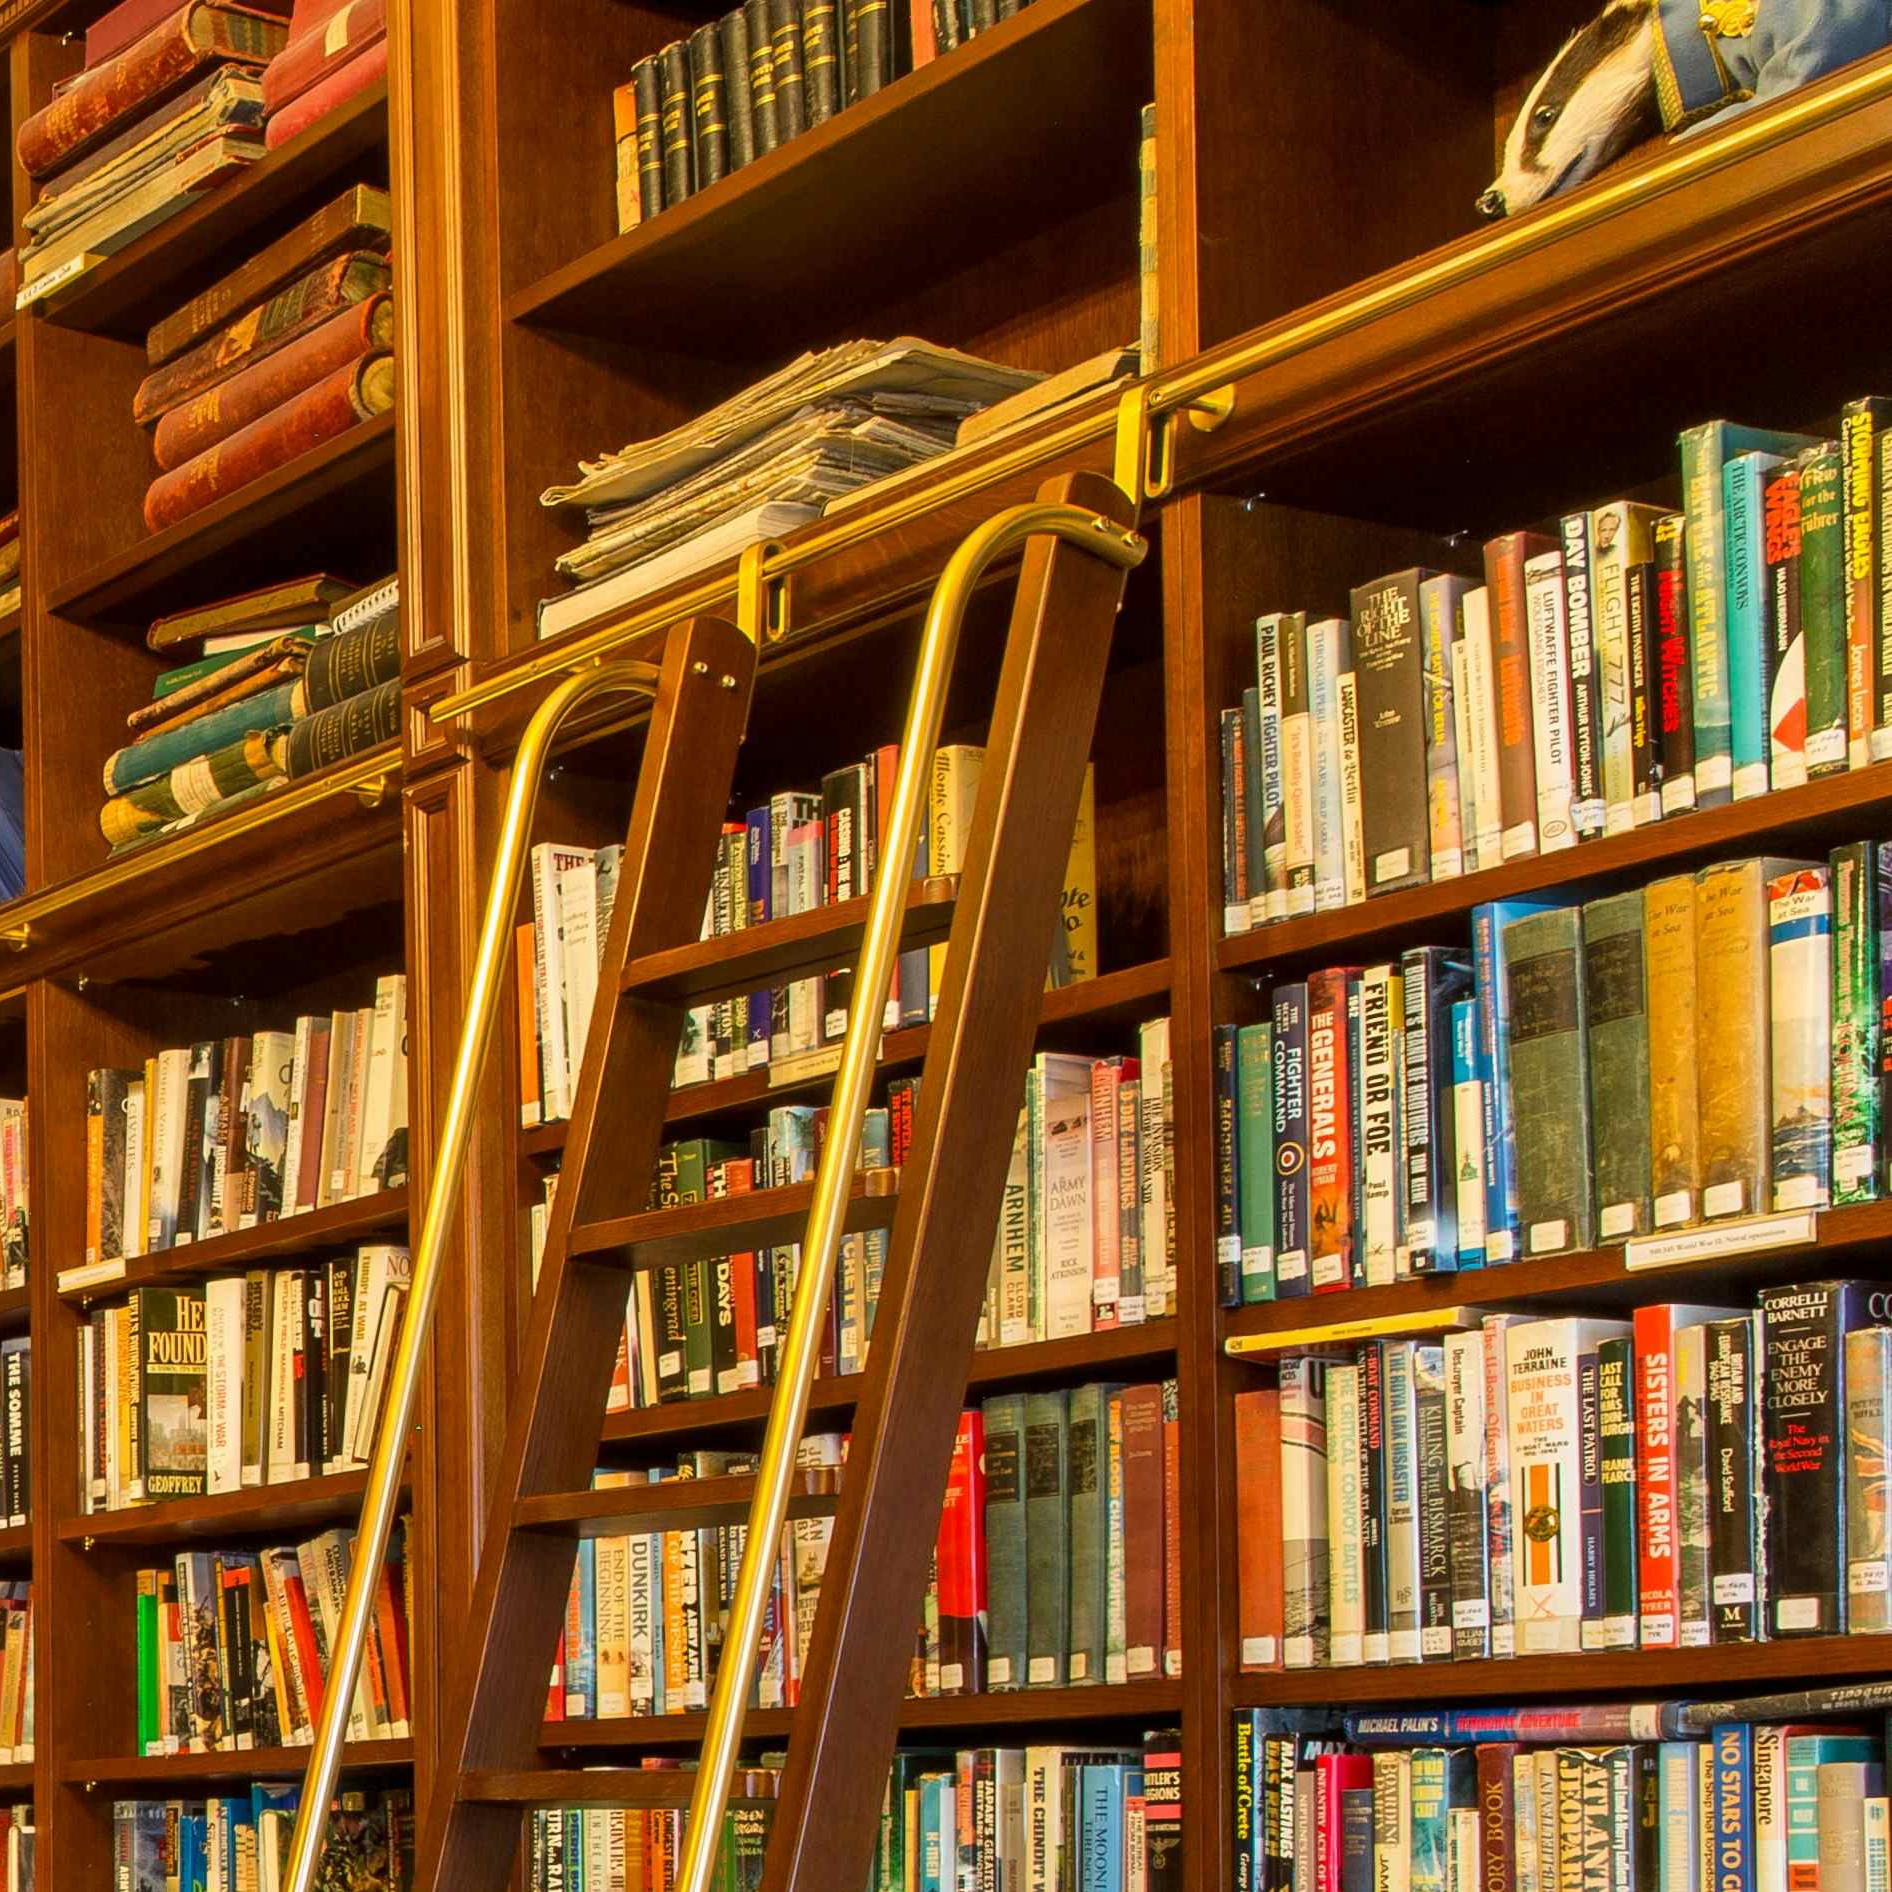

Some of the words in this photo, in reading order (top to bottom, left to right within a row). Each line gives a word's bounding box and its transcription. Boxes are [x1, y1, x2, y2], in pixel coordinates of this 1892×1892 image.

[1850, 412, 1872, 510] STORMING
[1563, 520, 1586, 567] DAY
[1851, 511, 1871, 578] EAGLES
[1604, 563, 1622, 642] FLIGHT
[1262, 625, 1275, 659] PAUL
[1543, 591, 1557, 666] LUFTWAFFE
[1568, 573, 1591, 679] BOMBER
[1263, 662, 1277, 710] RICHEY
[1609, 647, 1625, 703] 777
[1547, 669, 1560, 725] FIGHTER
[1264, 714, 1279, 769] FIGHTER
[1550, 728, 1562, 764] PILOT
[1266, 772, 1280, 809] PILOT
[1775, 900, 1789, 908] The
[1792, 895, 1814, 904] War
[1791, 907, 1809, 915] Sea
[1311, 1012, 1334, 1029] THE
[1365, 984, 1390, 1067] FRIEND
[1273, 1041, 1286, 1133] COMMAND
[1286, 1047, 1302, 1121] FIGHTER
[1312, 1031, 1336, 1160] GENERALS
[1366, 1073, 1390, 1105] OR
[1367, 1114, 1391, 1158] FOE
[1765, 1292, 1828, 1311] CORRELLI
[1767, 1306, 1828, 1322] BARNETT
[1524, 1347, 1553, 1360] JOHN
[1768, 1336, 1827, 1355] ENGAGE
[1781, 1352, 1810, 1365] THE
[8, 1352, 21, 1386] THE
[1511, 1375, 1572, 1392] BUSINESS
[1513, 1356, 1567, 1375] TERRAINE
[1772, 1364, 1823, 1380] ENEMY
[1531, 1392, 1544, 1402] IN
[1646, 1353, 1669, 1449] SISTERS
[1767, 1391, 1828, 1408] CLOSELY
[1777, 1378, 1818, 1393] MORE
[9, 1389, 22, 1456] SOMME
[1517, 1419, 1564, 1435] WATERS
[1521, 1403, 1559, 1419] GREAT
[148, 1476, 203, 1493] GEOFFREY
[1648, 1455, 1668, 1481] IN
[1649, 1494, 1671, 1559] ARMS
[632, 1542, 647, 1639] DUNKIRK
[1238, 1723, 1252, 1772] Battle
[1721, 1732, 1741, 1763] NO
[1034, 1768, 1044, 1802] THE
[1238, 1777, 1252, 1790] of
[1756, 1732, 1779, 1826] Singapore
[1238, 1790, 1252, 1839] Crete
[1721, 1769, 1741, 1834] STARS
[1033, 1808, 1045, 1877] CHINDIT
[1723, 1841, 1741, 1867] TO
